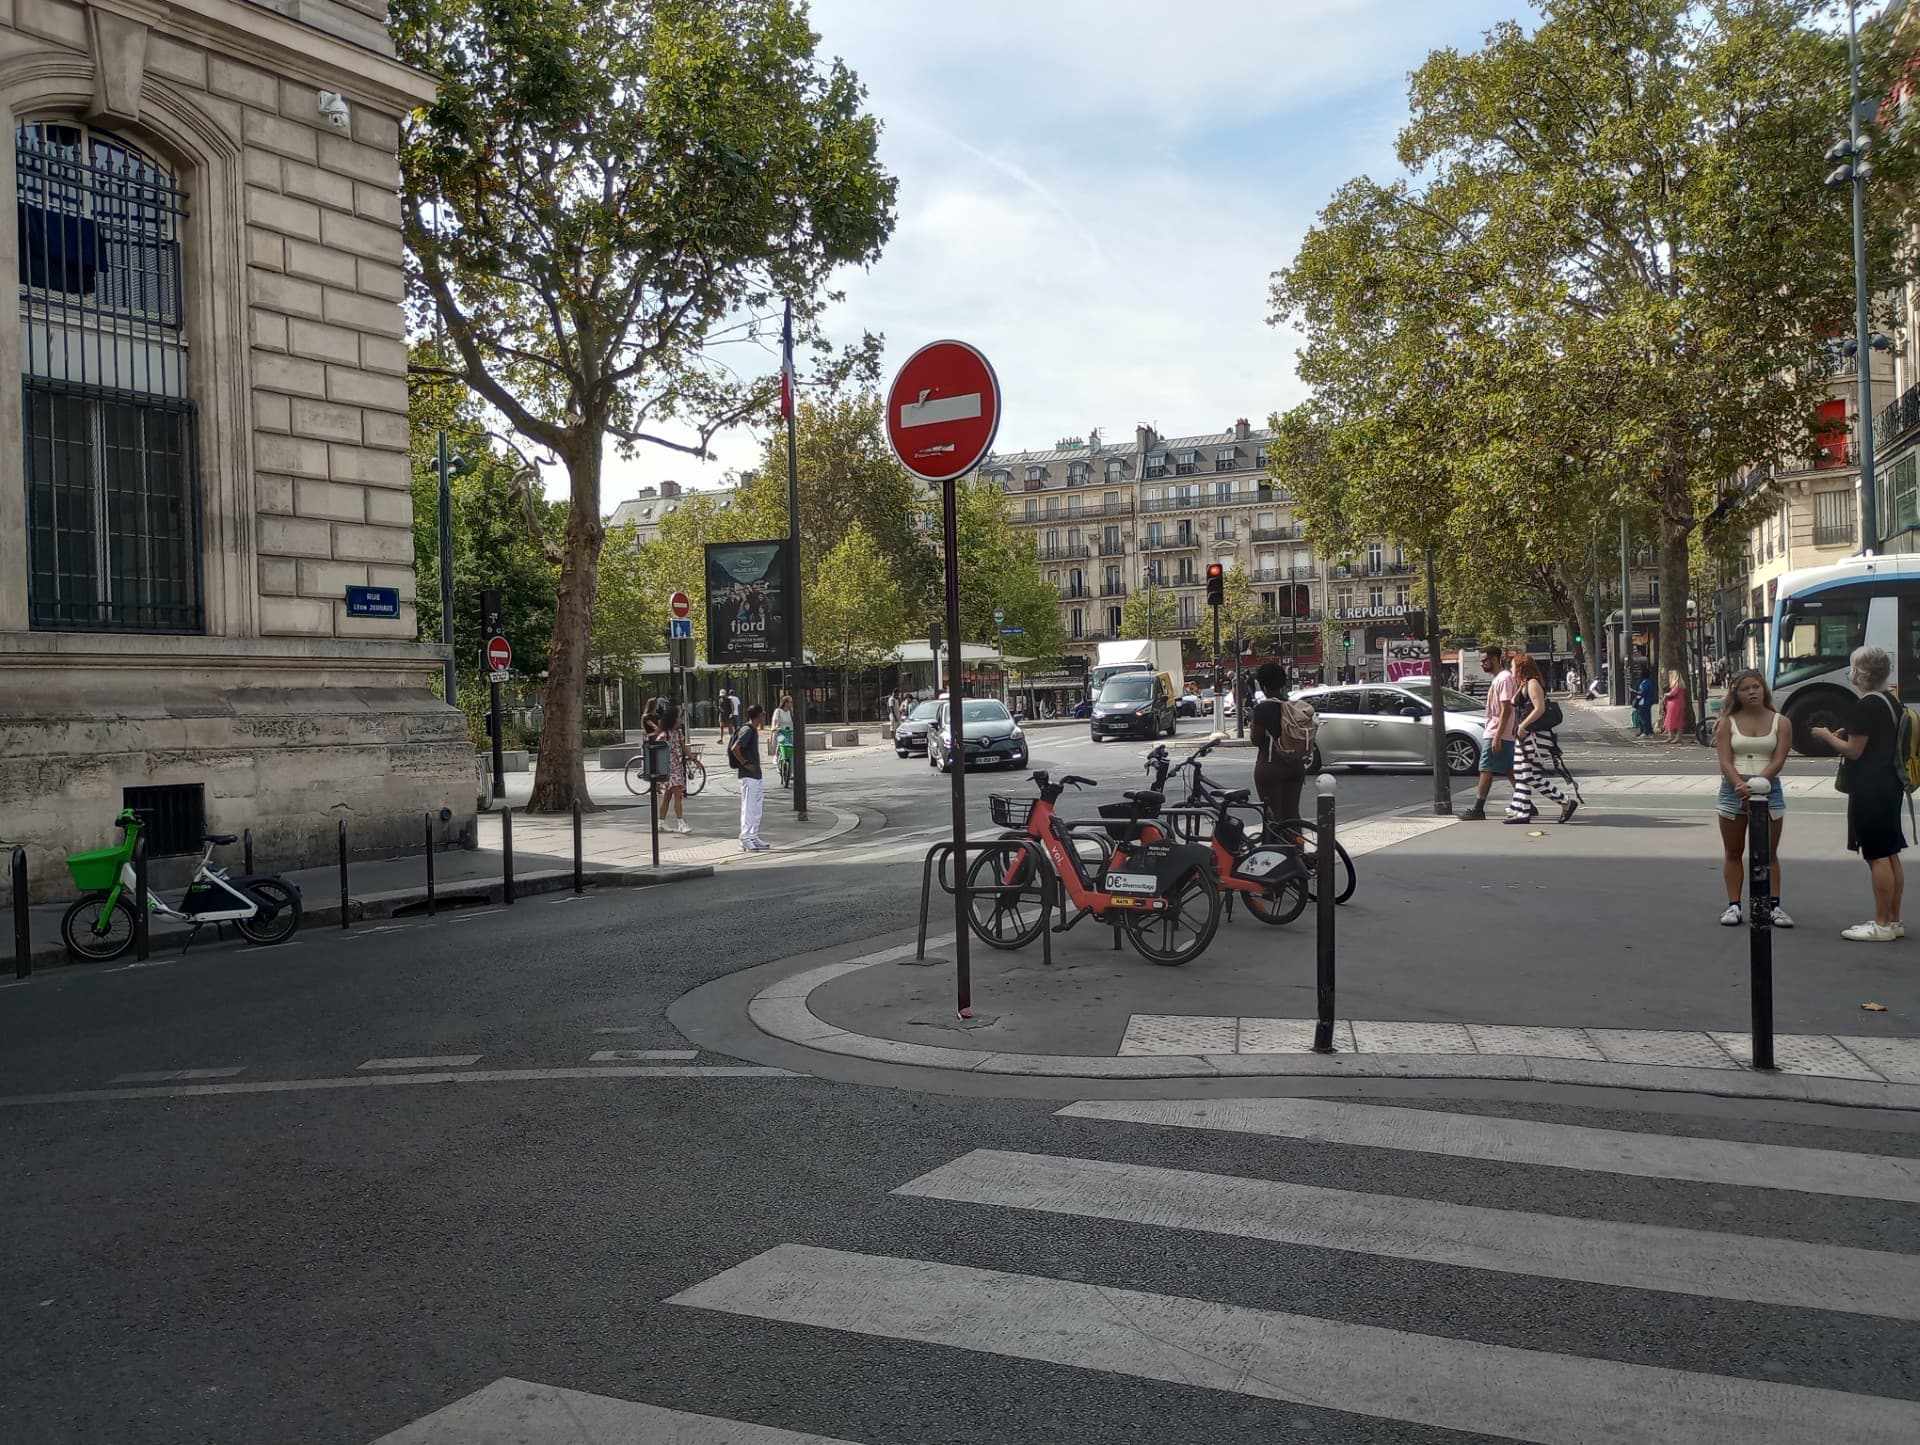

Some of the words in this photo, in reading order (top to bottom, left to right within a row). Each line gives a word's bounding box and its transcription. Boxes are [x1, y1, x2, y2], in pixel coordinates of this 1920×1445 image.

[366, 592, 381, 601] RUE
[730, 616, 765, 635] fjord
[1195, 661, 1212, 669] KFC
[1106, 875, 1122, 888] 0€
